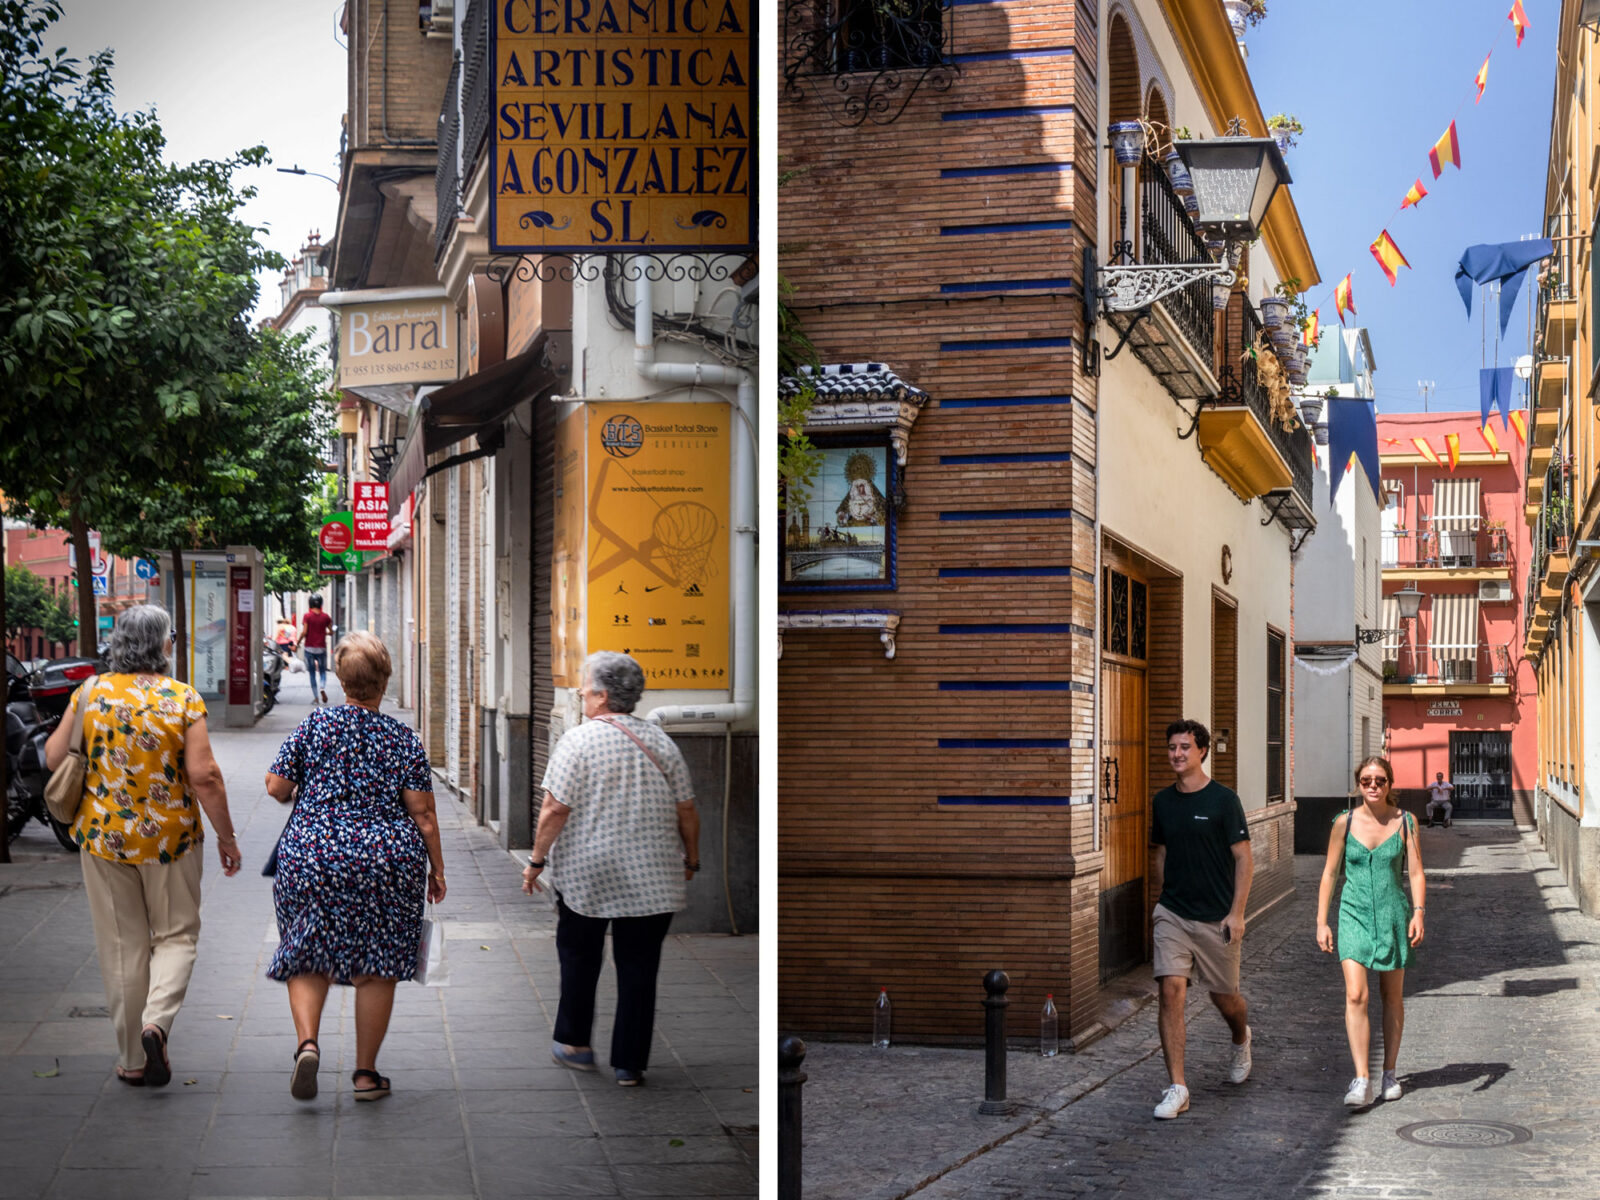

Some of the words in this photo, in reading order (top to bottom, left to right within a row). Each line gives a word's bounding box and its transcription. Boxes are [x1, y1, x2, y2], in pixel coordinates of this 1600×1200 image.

[501, 48, 747, 87] ARTISTICA
[499, 101, 747, 141] SEVILLANA
[590, 199, 655, 243] S.L.
[349, 305, 448, 357] Barral
[606, 423, 641, 441] BTS
[645, 424, 673, 433] Basket
[675, 424, 695, 433] Total
[696, 424, 718, 433] Store
[357, 500, 388, 510] ASIA
[358, 522, 388, 530] CHINO
[370, 531, 376, 539] Y
